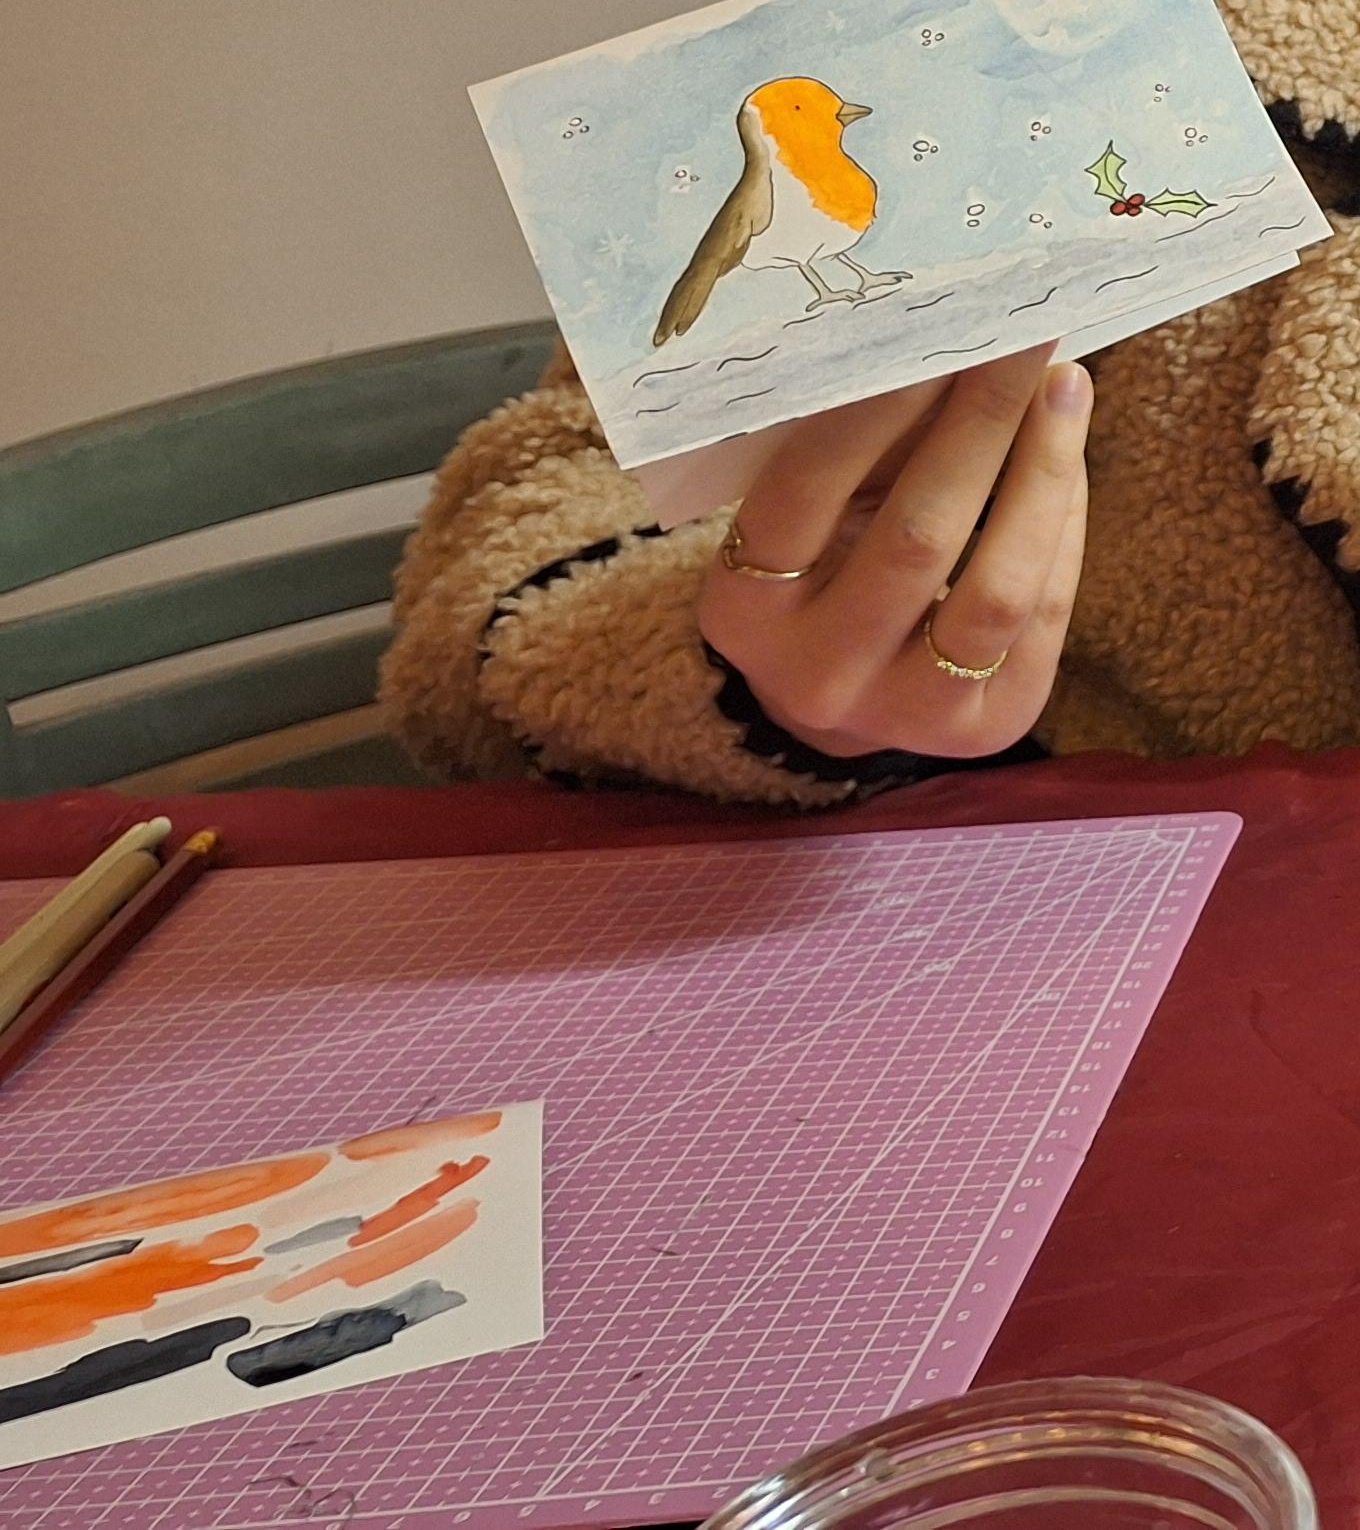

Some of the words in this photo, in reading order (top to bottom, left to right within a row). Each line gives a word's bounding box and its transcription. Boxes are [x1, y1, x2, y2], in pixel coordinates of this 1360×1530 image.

[1080, 1062, 1101, 1071] 15
[1070, 1084, 1091, 1093] 14
[1058, 1107, 1080, 1116] 13
[1045, 1129, 1069, 1138] 12
[1035, 1153, 1056, 1162] 11
[1020, 1178, 1044, 1187] 10
[1013, 1203, 1027, 1213] 9
[985, 1255, 999, 1265] 7
[971, 1282, 986, 1293] 6
[956, 1311, 971, 1321] 5
[941, 1340, 956, 1350] 4
[925, 1368, 940, 1380] 3
[907, 1399, 924, 1409] 2
